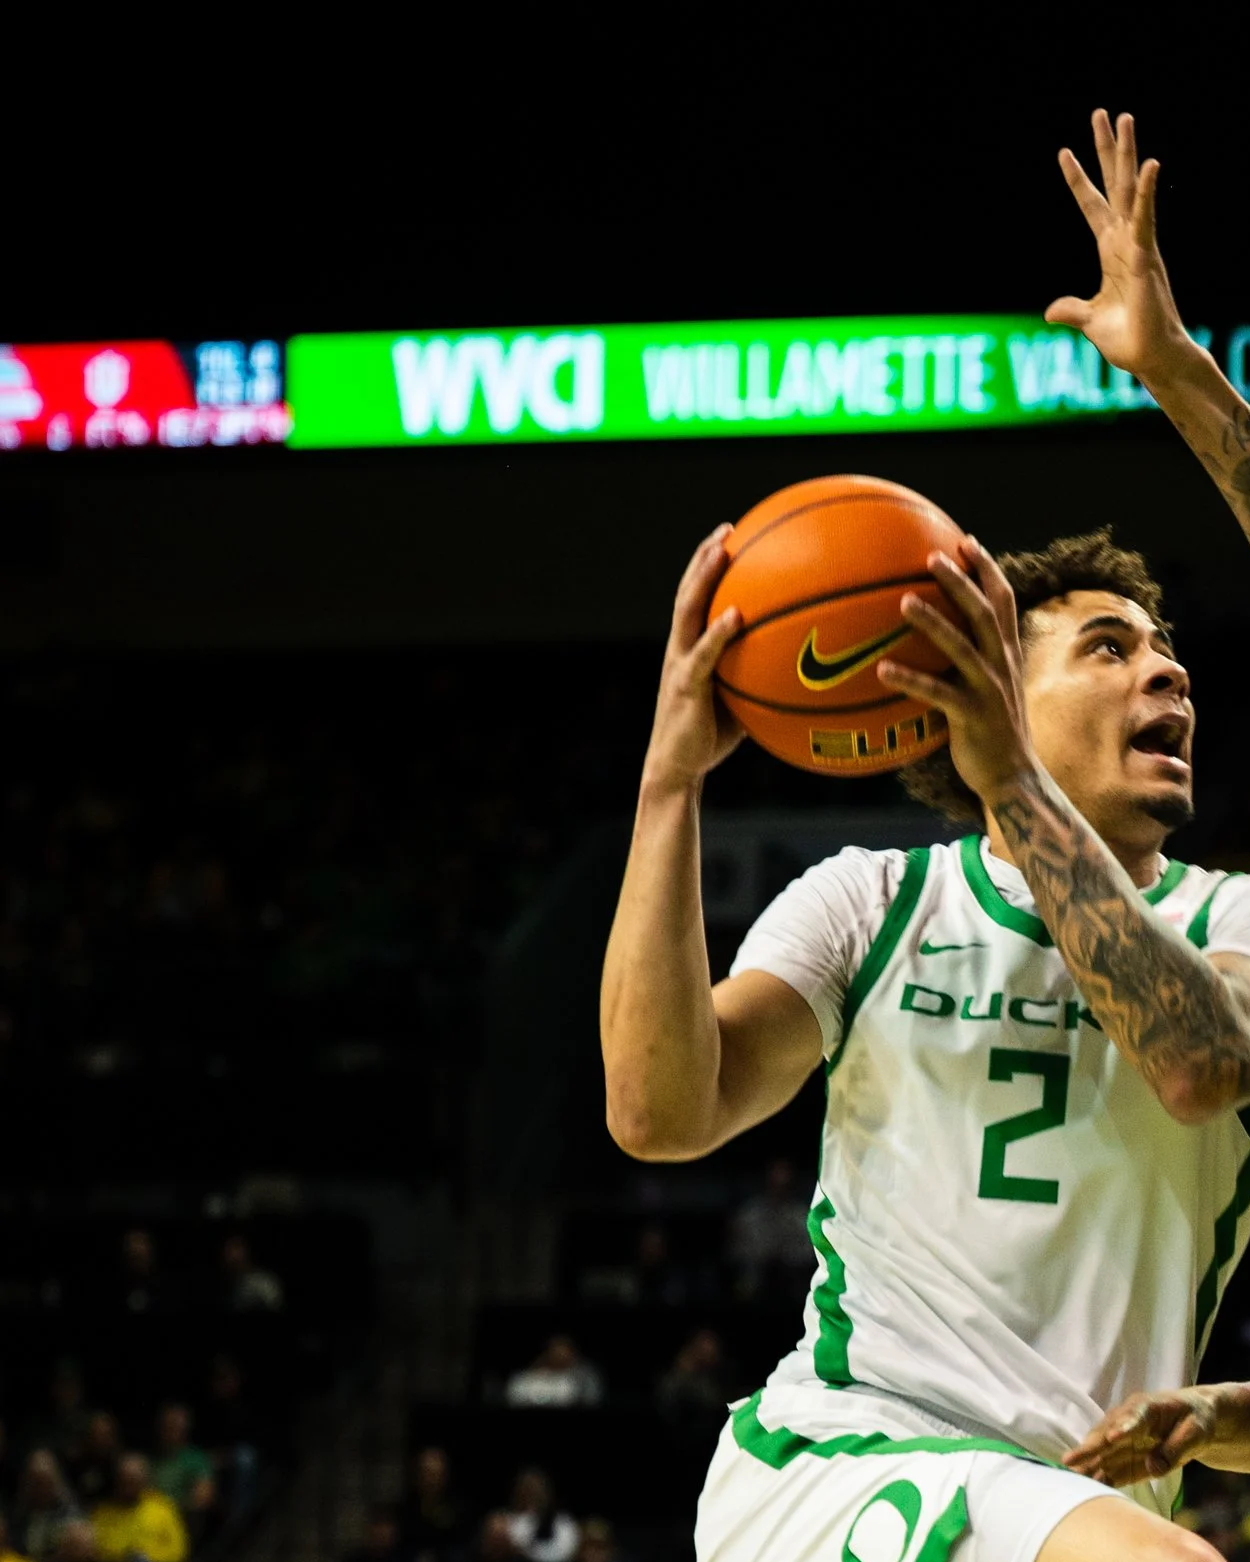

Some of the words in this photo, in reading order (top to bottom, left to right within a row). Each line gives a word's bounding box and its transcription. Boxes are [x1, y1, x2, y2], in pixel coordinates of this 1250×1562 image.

[642, 333, 996, 421] WILLAMETTE
[809, 711, 949, 765] ELIT
[900, 983, 1104, 1032] DUCK
[977, 1047, 1071, 1204] 2
